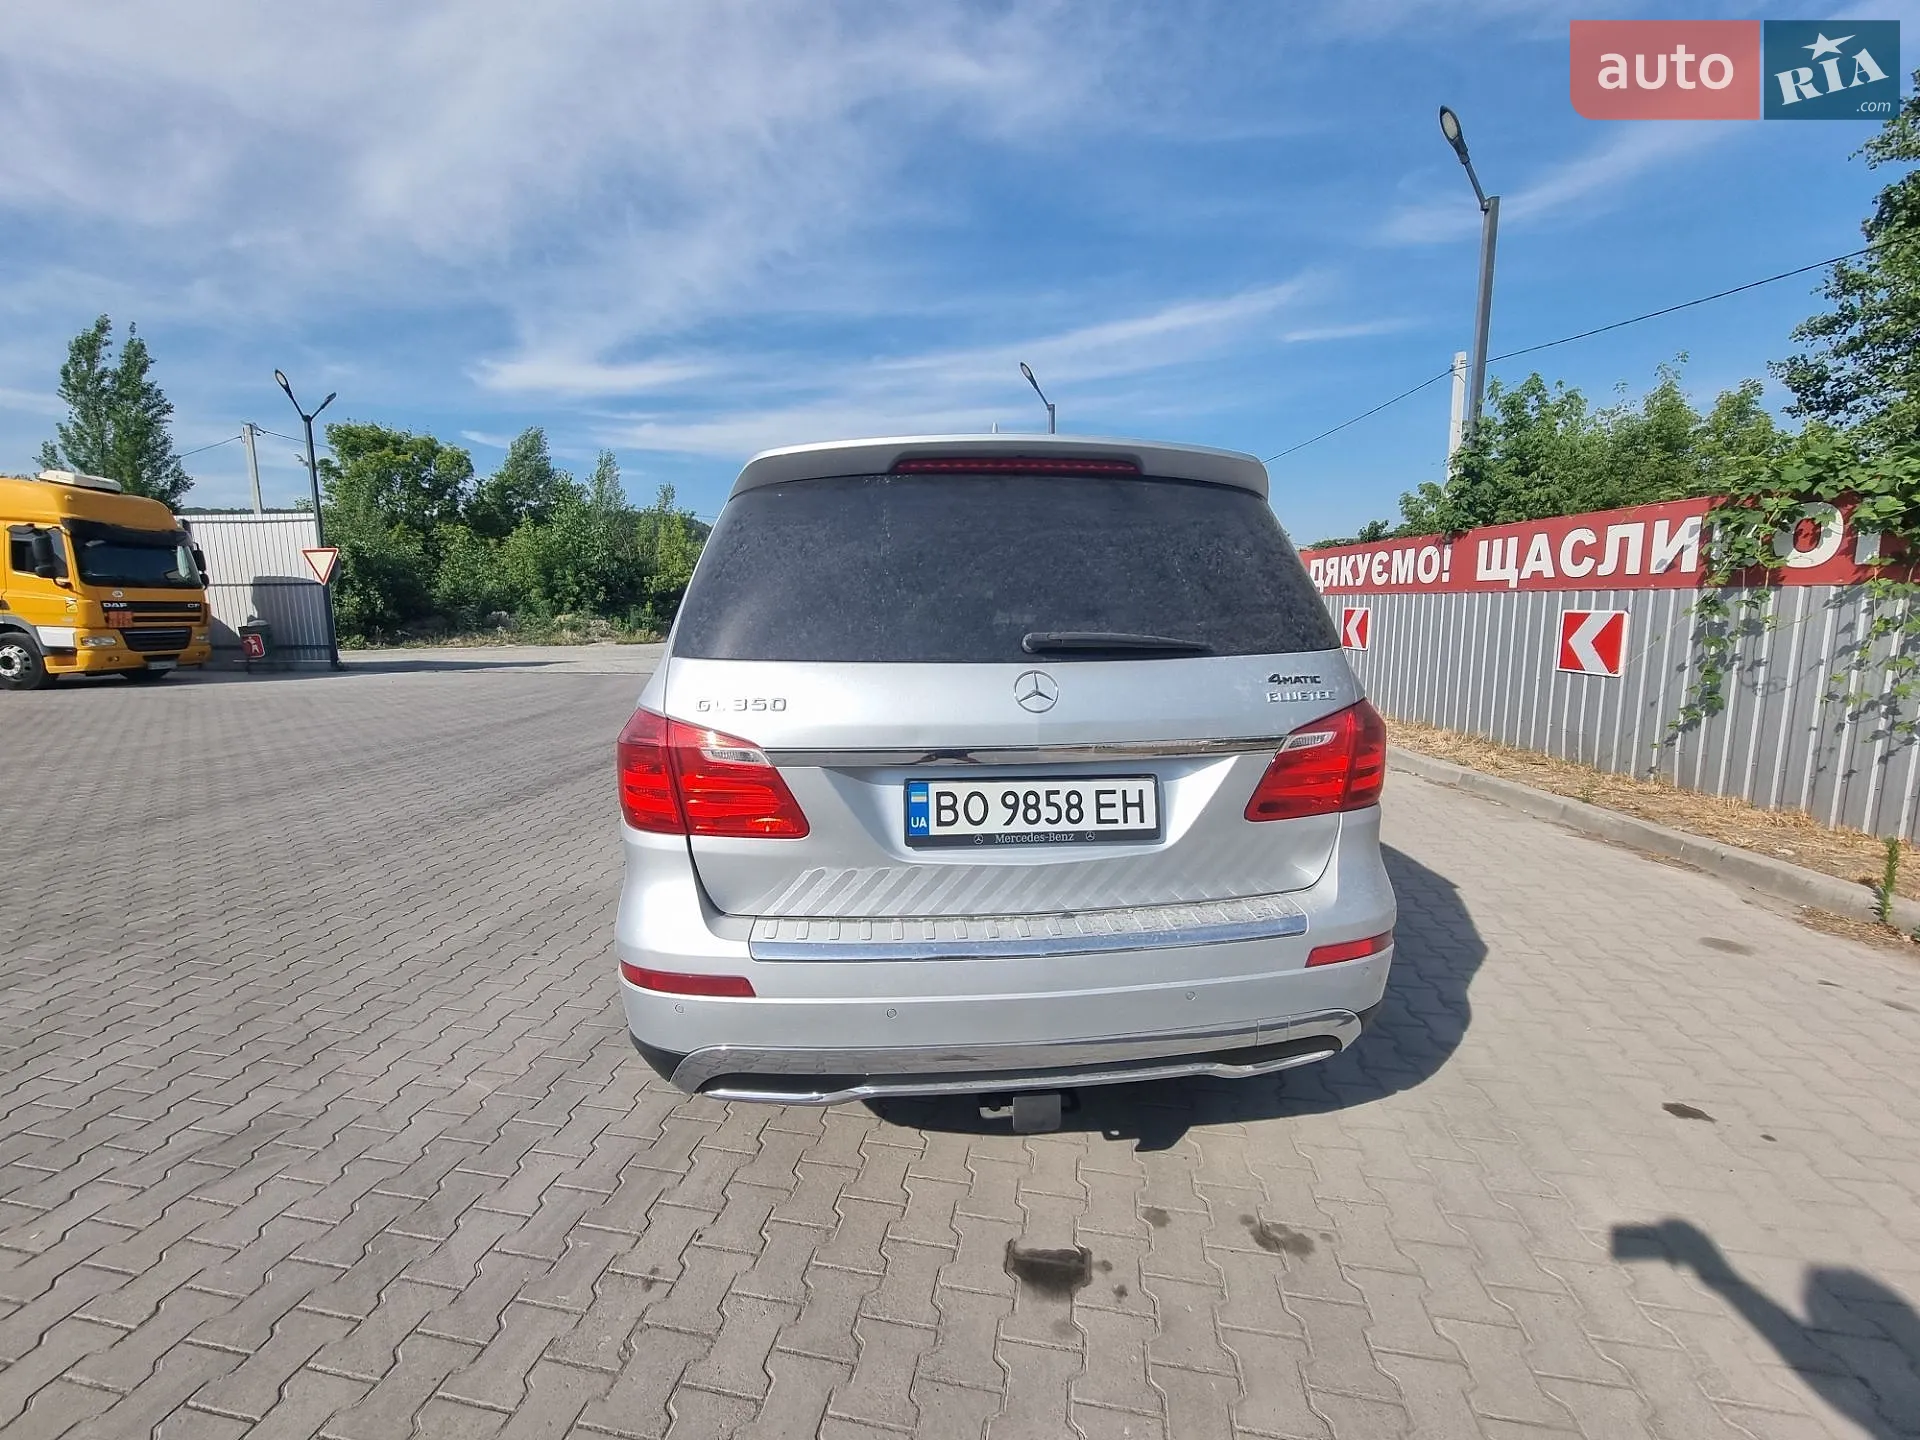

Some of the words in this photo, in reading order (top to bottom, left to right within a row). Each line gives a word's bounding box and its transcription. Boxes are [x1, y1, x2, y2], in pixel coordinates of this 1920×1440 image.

[1309, 544, 1452, 593] ДЯКУЄМО!
[1476, 500, 1881, 589] ЩАСЛИО
[1267, 673, 1322, 685] 4MATIC
[733, 698, 787, 712] 350
[935, 791, 989, 827] BO
[1000, 789, 1084, 826] 9858
[1095, 788, 1145, 825] EH
[911, 816, 927, 828] UA
[994, 832, 1075, 844] Mercedes-Benz
